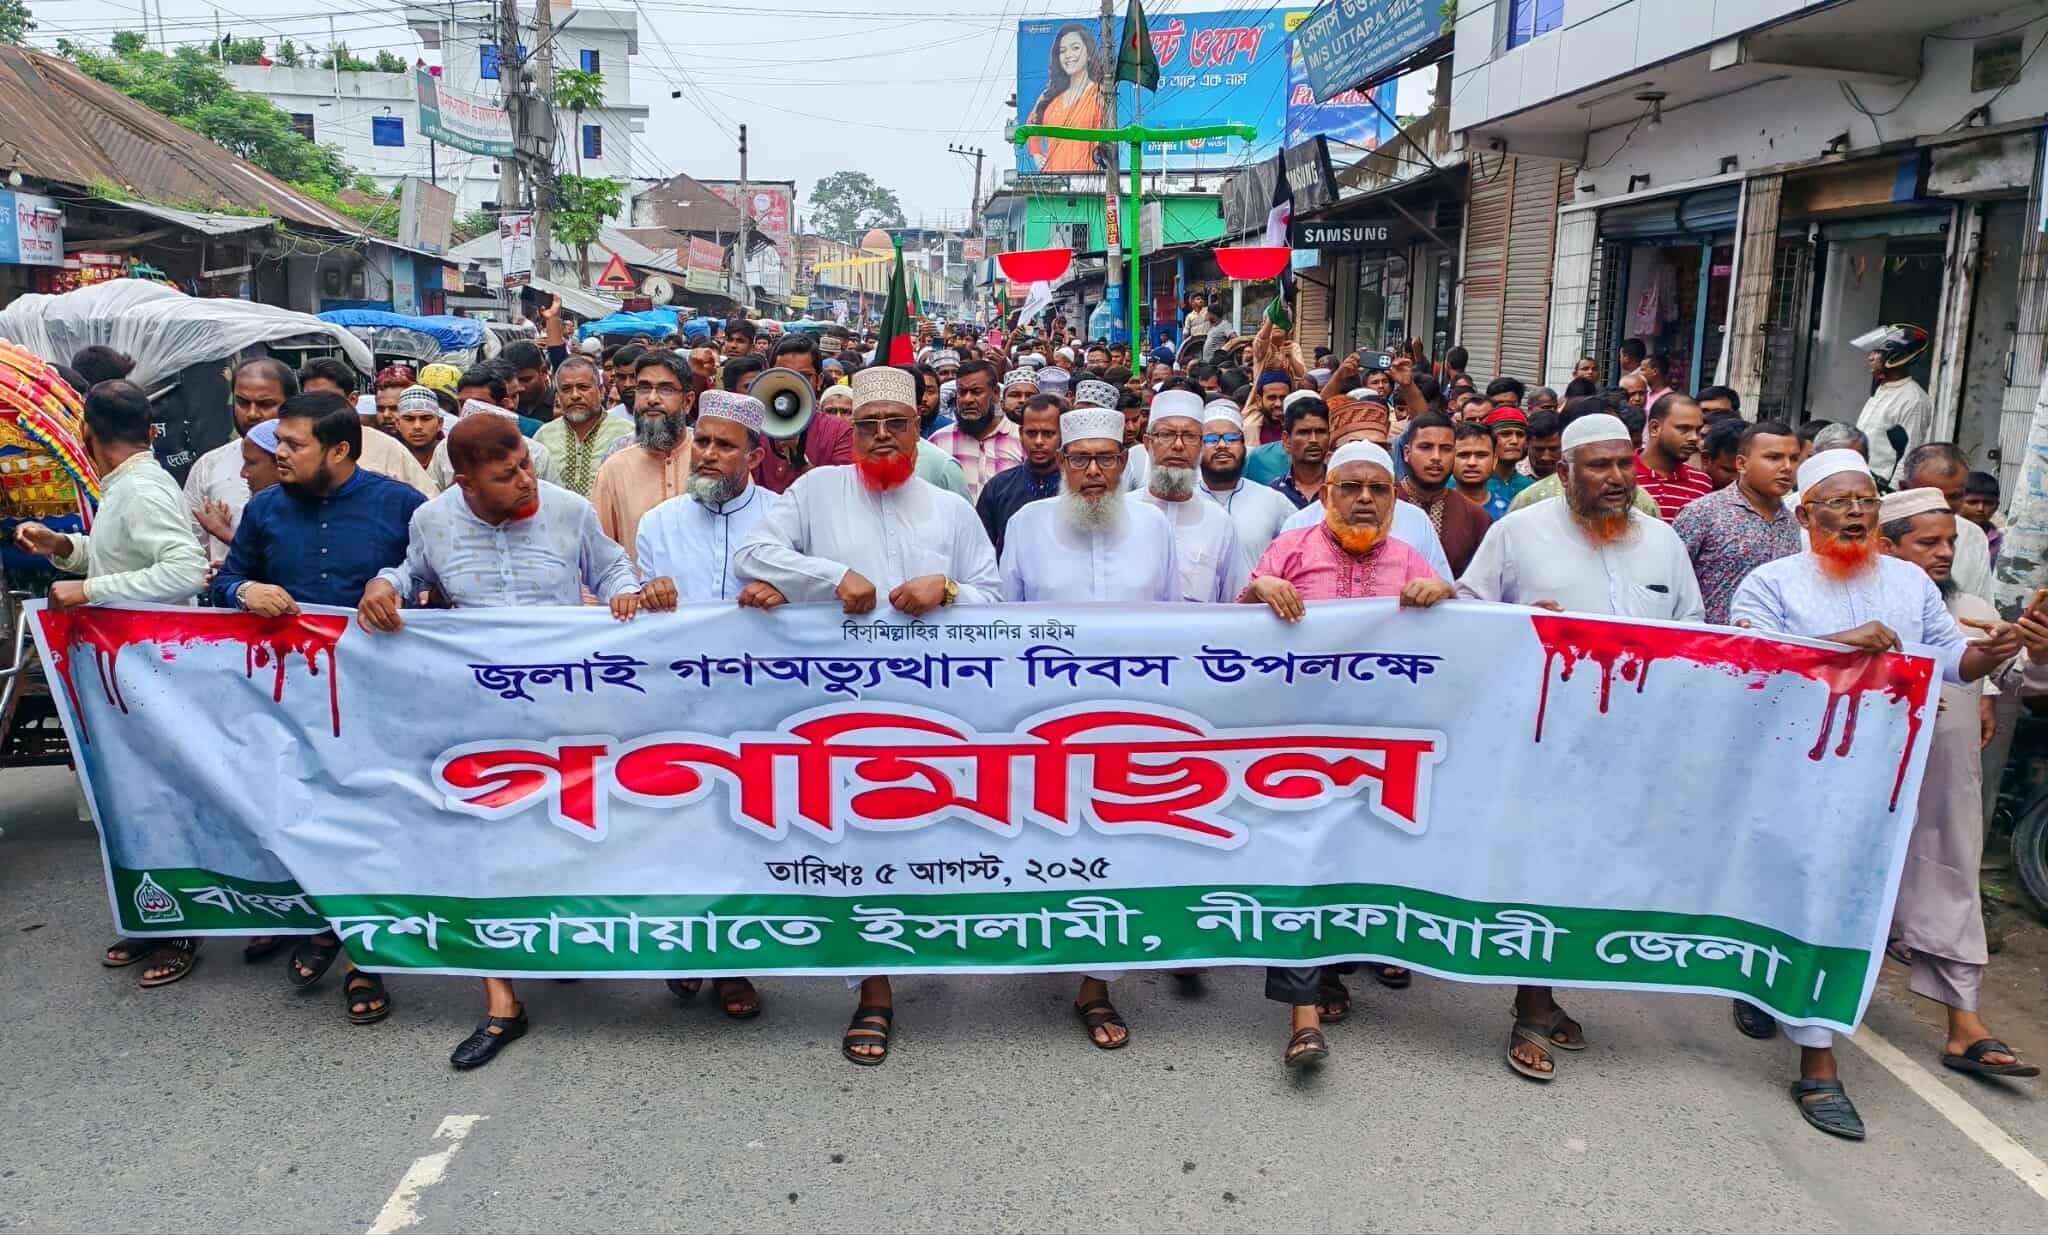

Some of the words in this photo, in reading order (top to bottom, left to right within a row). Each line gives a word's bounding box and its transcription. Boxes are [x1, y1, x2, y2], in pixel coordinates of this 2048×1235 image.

[1308, 46, 1330, 69] M/S
[1331, 11, 1386, 54] UTTARA
[1285, 160, 1319, 192] MSUNG
[1304, 226, 1388, 244] SAMSUNG
[1028, 619, 1078, 641] রাহীম
[467, 651, 650, 702] জুলাই
[669, 652, 1005, 698] গণঅভ্যুত্থান
[1017, 644, 1179, 688] দিবস
[1194, 644, 1446, 685] উপলক্ষে
[442, 711, 1434, 840] গণমিছিল
[875, 864, 898, 886] ৫
[908, 851, 1012, 887] আগস্ট,
[1025, 856, 1112, 884] ২০২৫
[464, 911, 834, 955] জামায়াতে
[850, 896, 1162, 954] ইসলামী,
[1186, 891, 1571, 963] নীলফামারী
